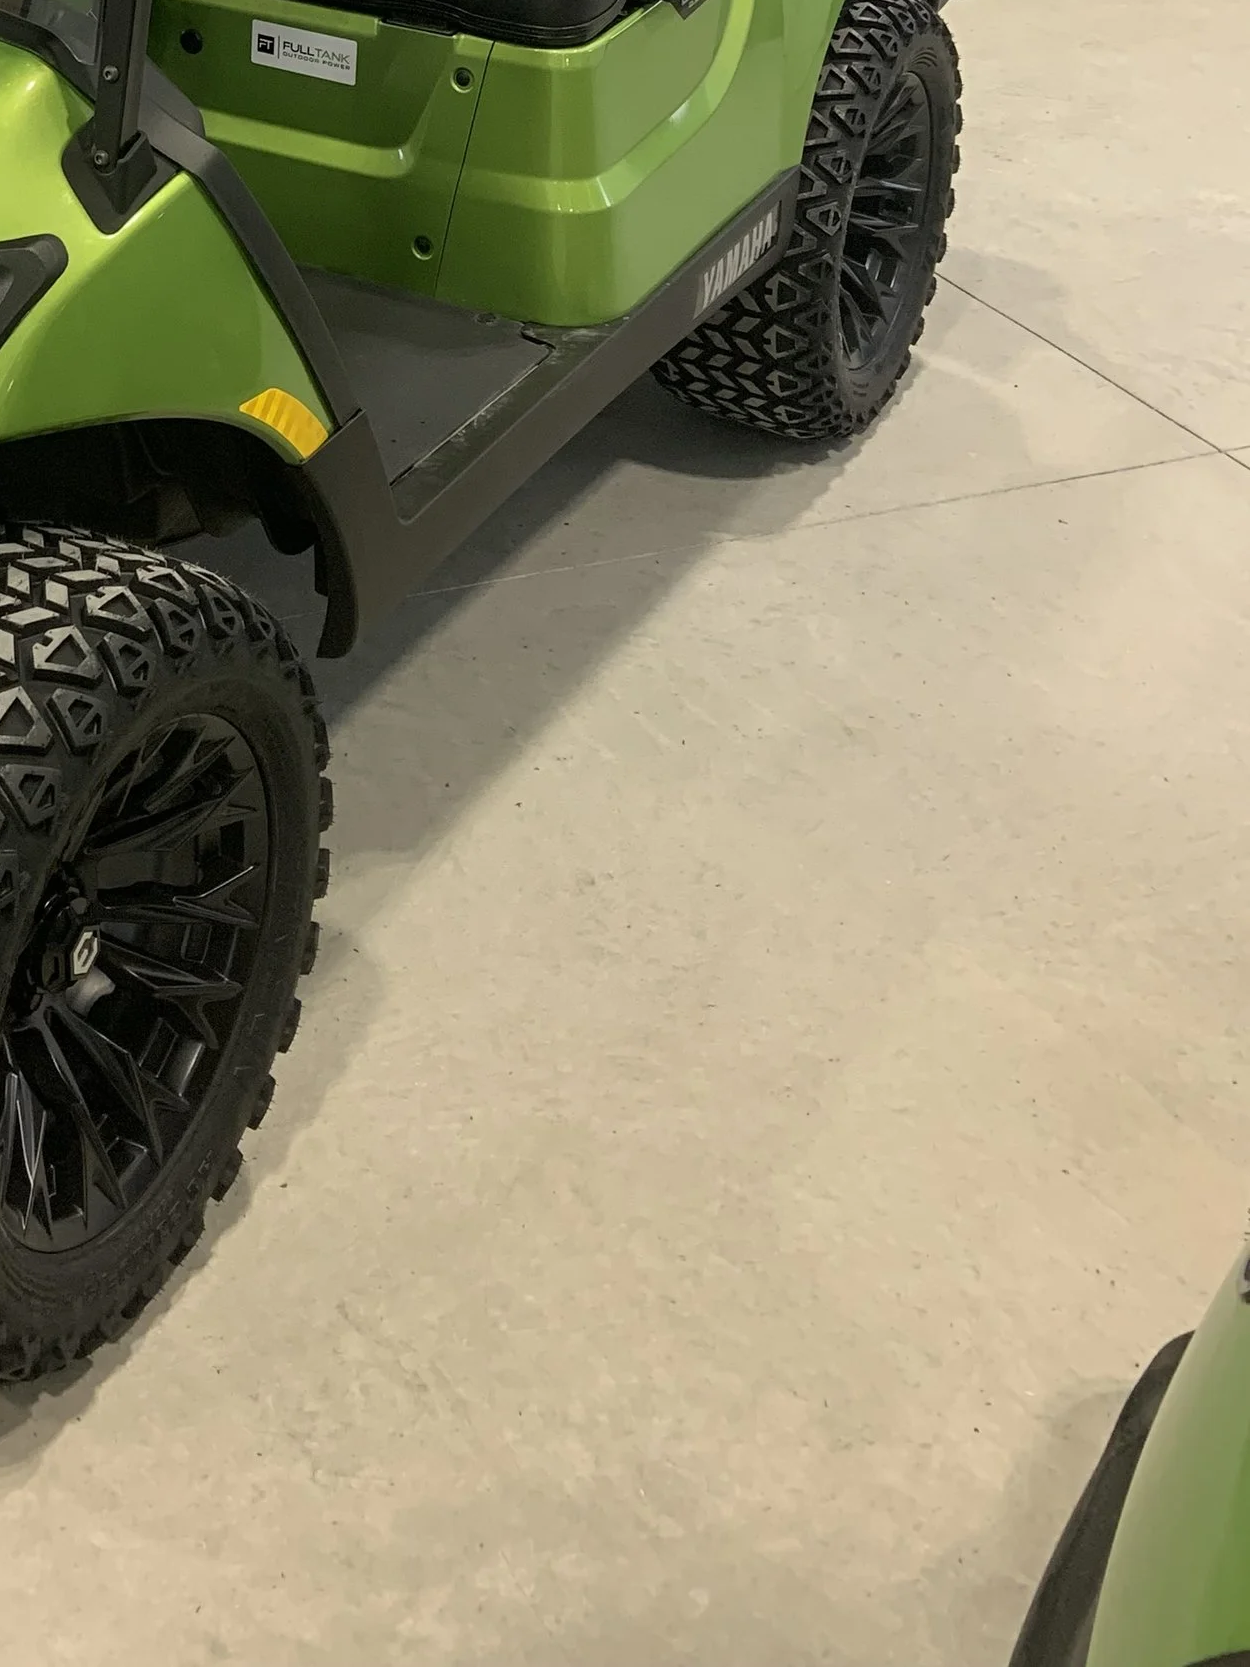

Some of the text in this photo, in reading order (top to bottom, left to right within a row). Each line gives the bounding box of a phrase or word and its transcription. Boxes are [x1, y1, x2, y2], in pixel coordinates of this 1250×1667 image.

[259, 38, 273, 51] FT
[282, 51, 351, 71] OUTDOOR POWER
[703, 212, 773, 310] YAMAHA
